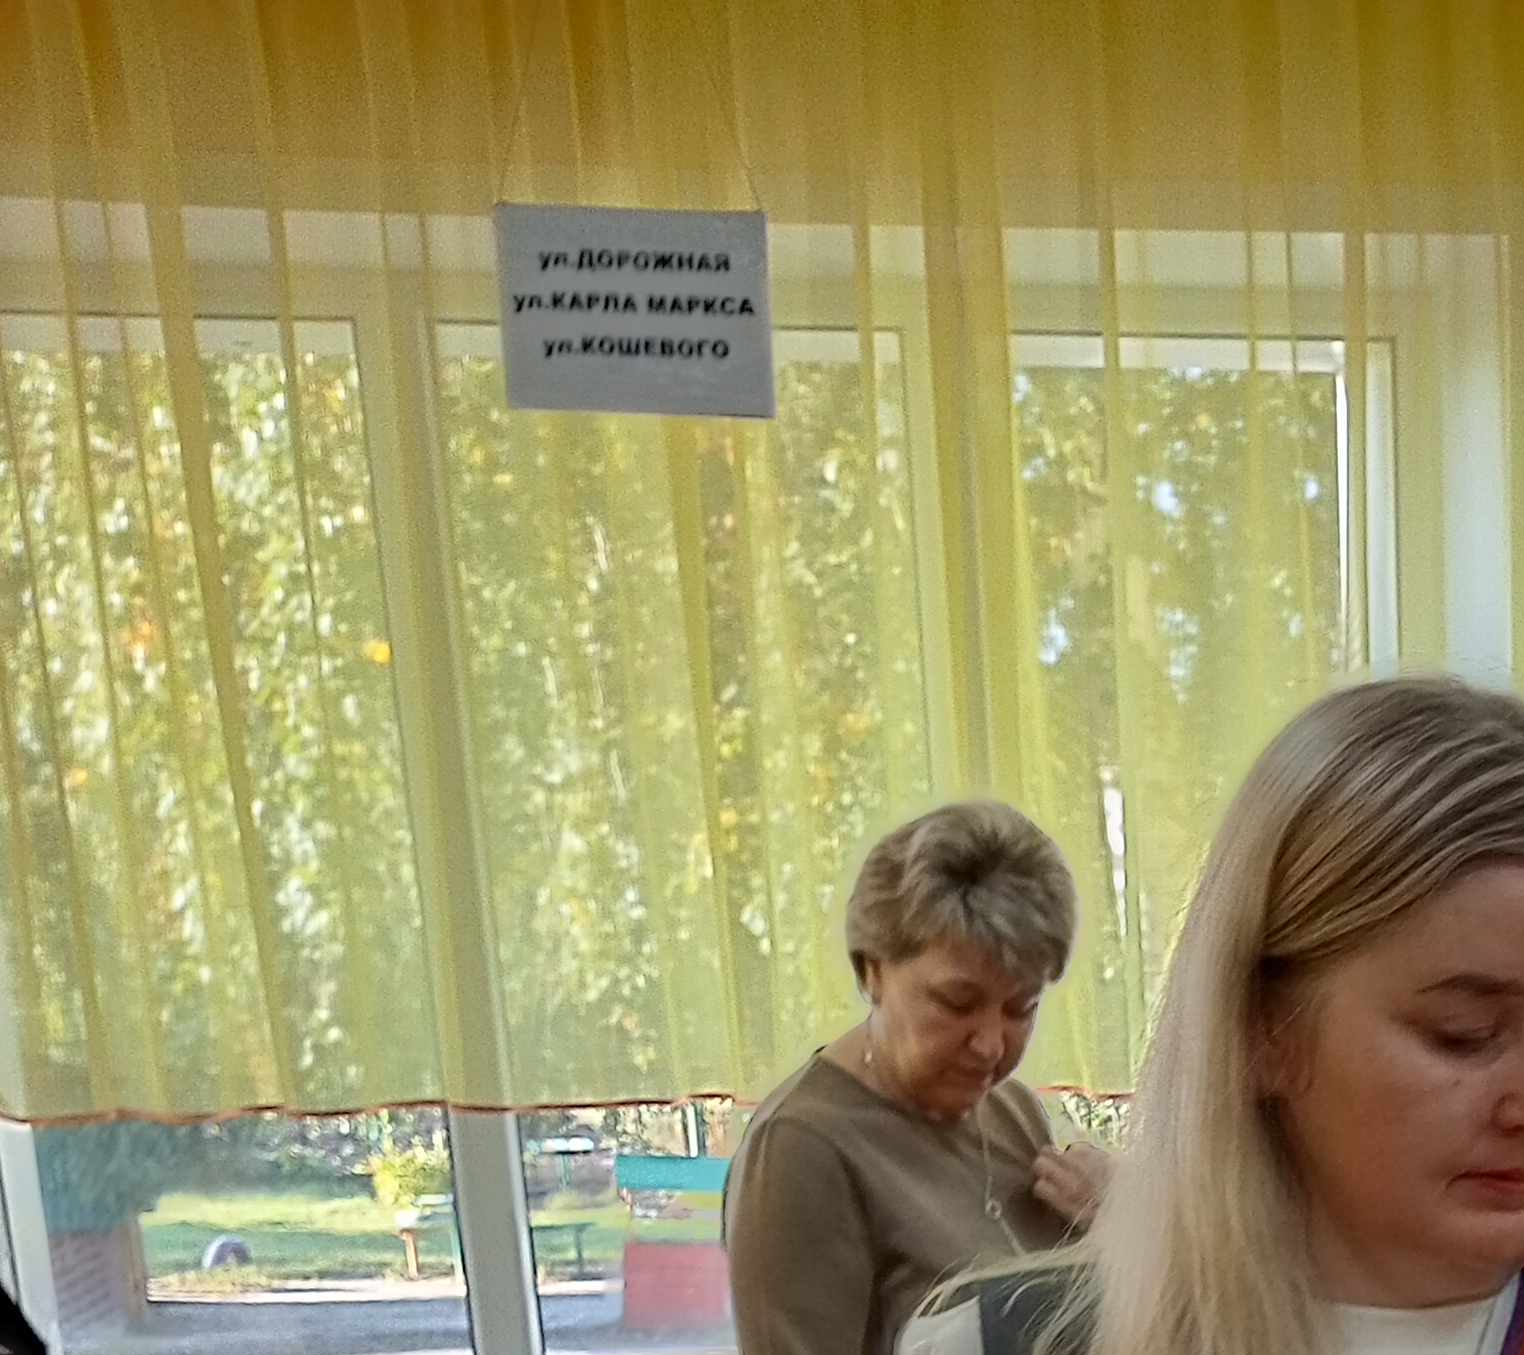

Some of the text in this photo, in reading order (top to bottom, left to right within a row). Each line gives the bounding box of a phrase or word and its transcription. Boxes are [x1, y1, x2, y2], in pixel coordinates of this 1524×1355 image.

[538, 248, 731, 272] ул.ДОРОЖНАЯ
[648, 295, 755, 316] МАРКСА
[543, 336, 731, 359] ул.КОШЕВОГО
